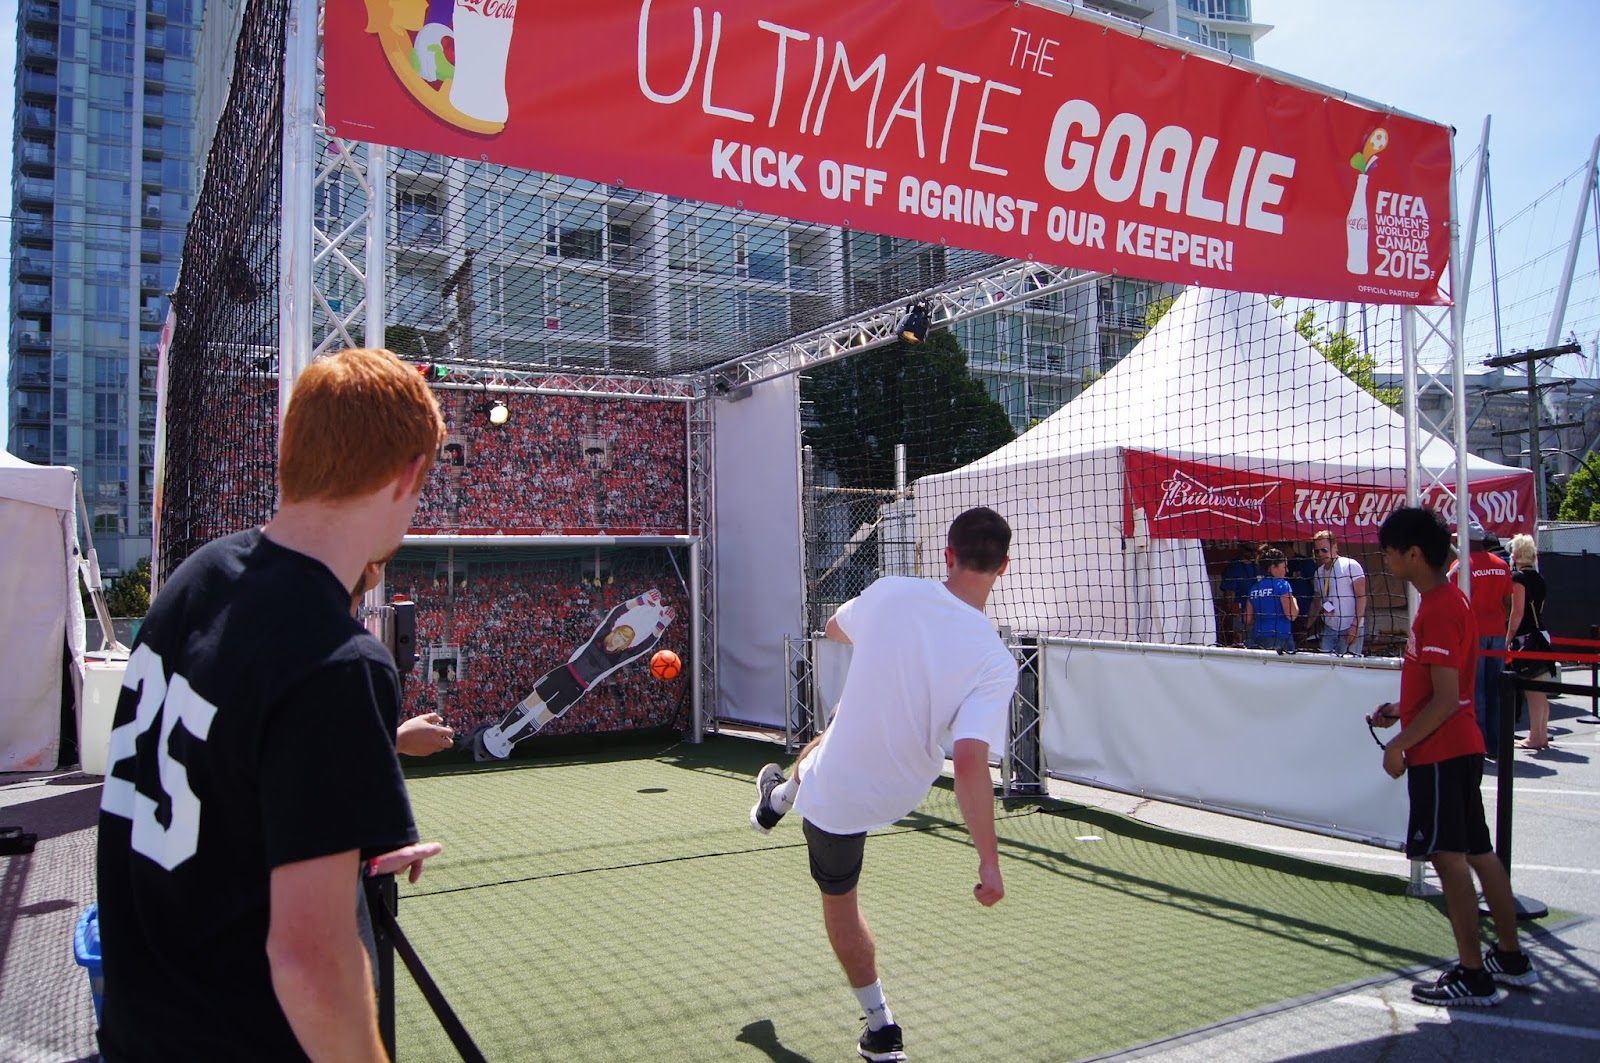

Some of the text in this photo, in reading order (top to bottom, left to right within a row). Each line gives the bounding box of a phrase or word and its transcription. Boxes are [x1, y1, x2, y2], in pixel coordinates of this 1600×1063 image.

[1009, 27, 1061, 77] THE
[637, 0, 1296, 234] ULTIMATE GOALIE
[711, 139, 1234, 272] KICK OFF AGAINST OUR KEEPER!
[1375, 190, 1429, 219] FIFA
[1375, 213, 1430, 230] WOMEN'S
[1375, 225, 1430, 240] WORLD CUP
[1375, 235, 1429, 254] CANADA
[1374, 248, 1430, 280] 2015
[1357, 285, 1420, 299] OFFICIAL PARTNER
[1292, 488, 1356, 526] THIS
[1476, 489, 1524, 524] YOU.
[1471, 568, 1506, 578] VOLUNTEER
[1250, 588, 1273, 600] STAFF
[100, 641, 219, 872] 25
